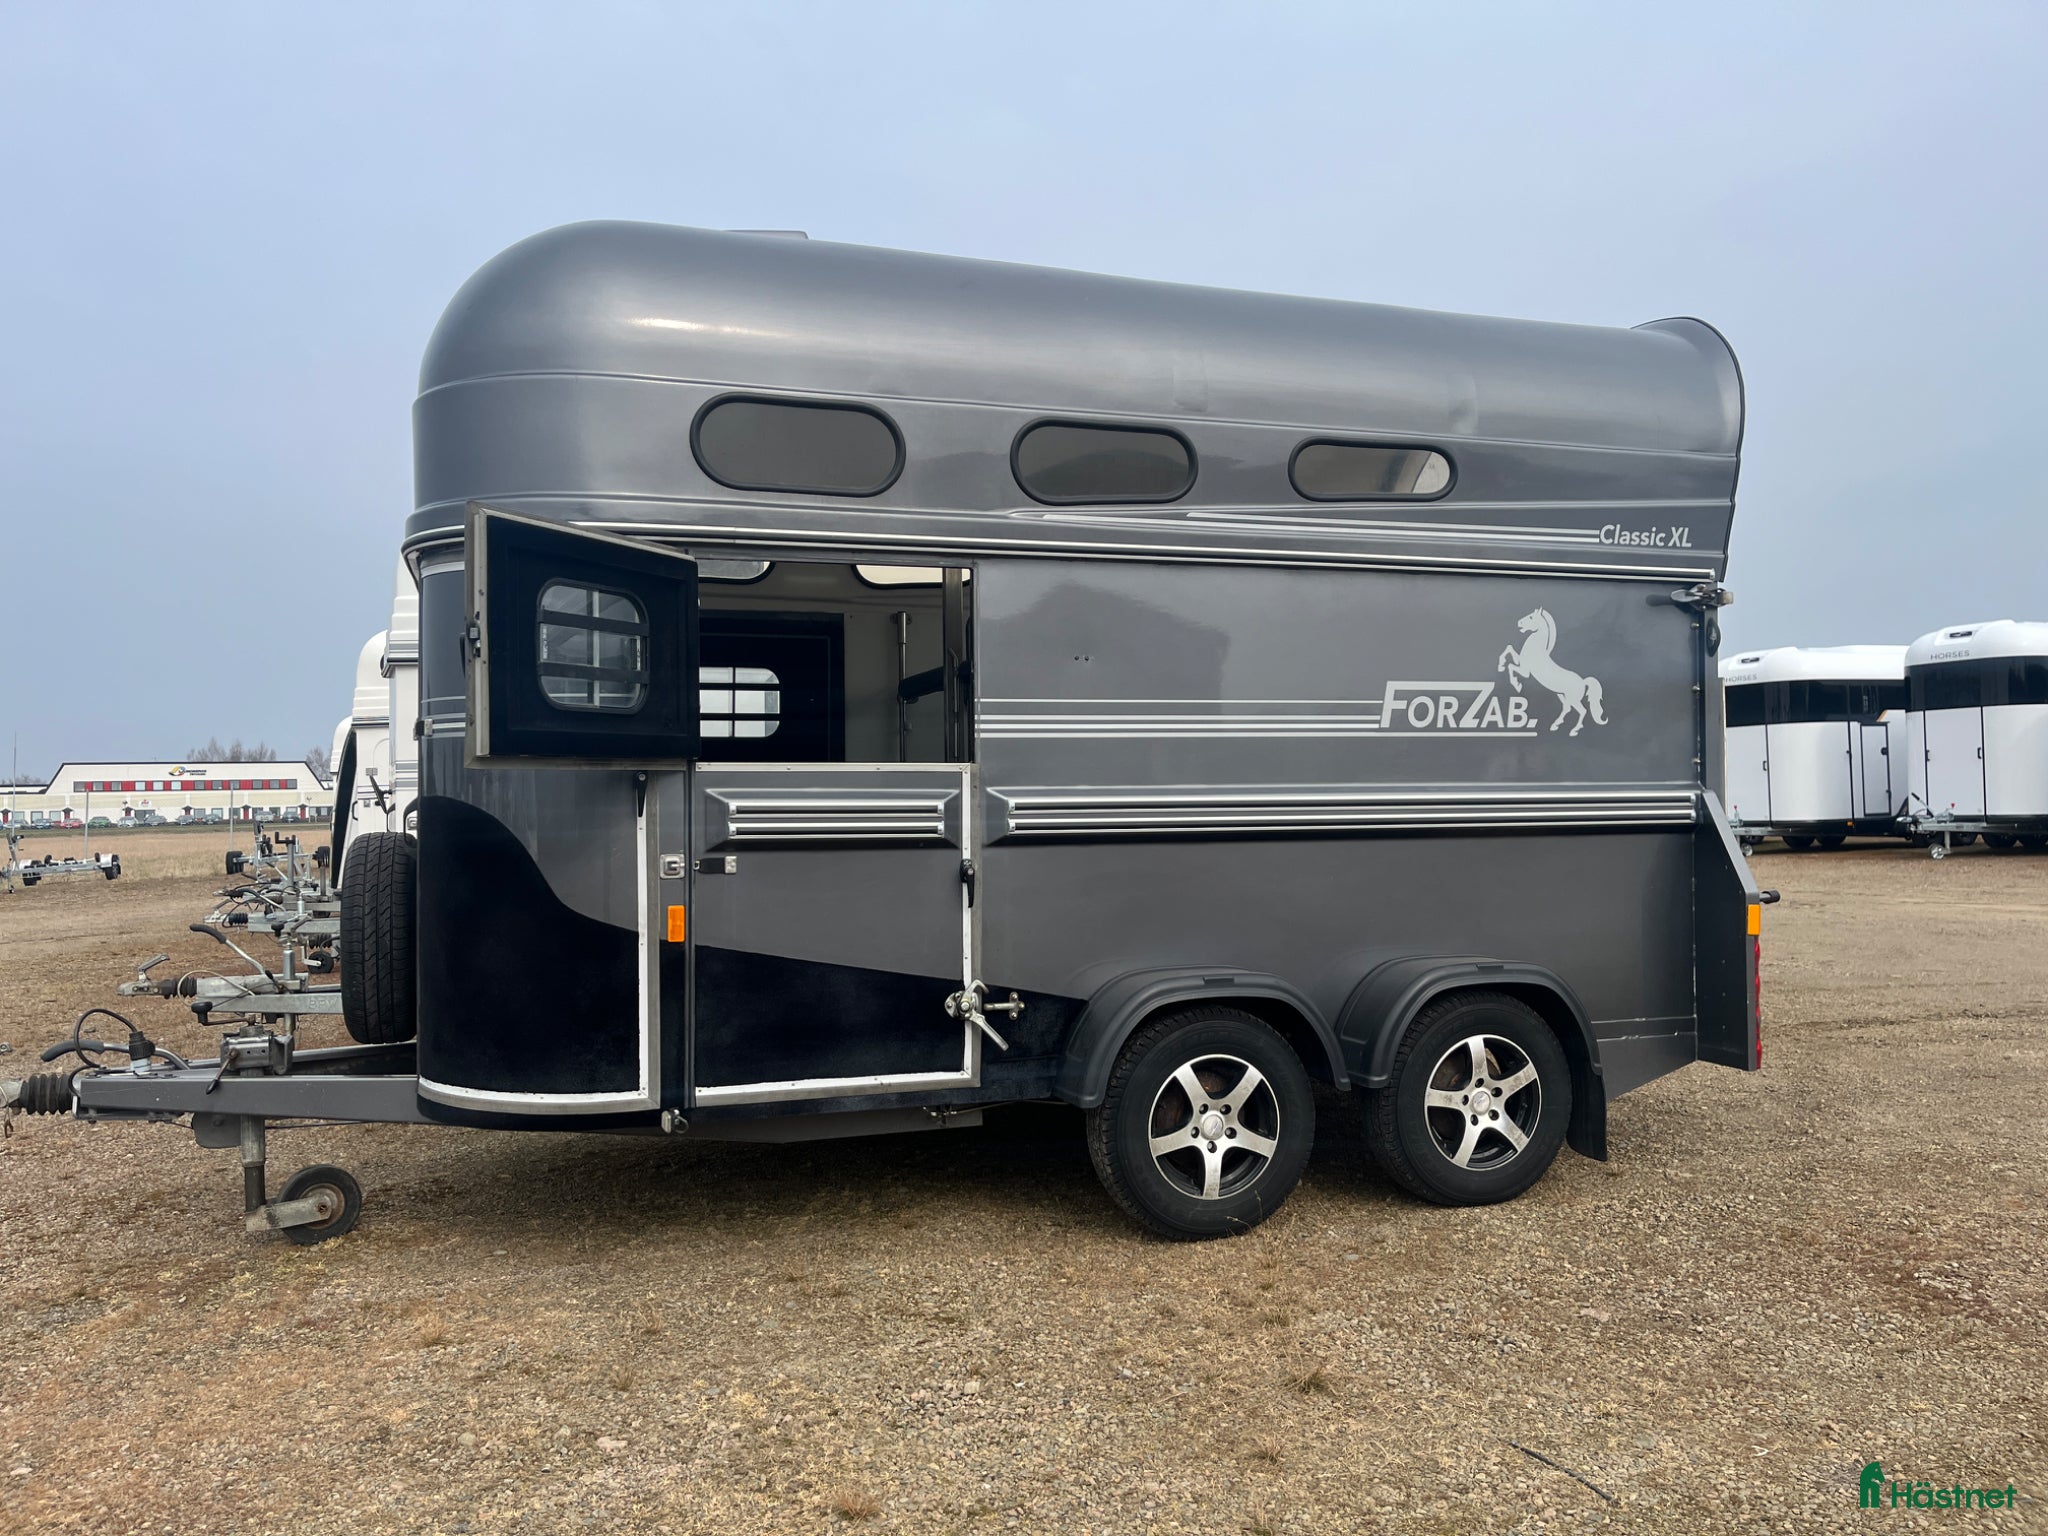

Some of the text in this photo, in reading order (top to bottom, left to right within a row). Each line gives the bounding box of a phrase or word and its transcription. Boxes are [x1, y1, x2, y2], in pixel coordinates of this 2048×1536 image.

[1600, 524, 1692, 548] Classic XL
[1930, 649, 1970, 661] HORSES
